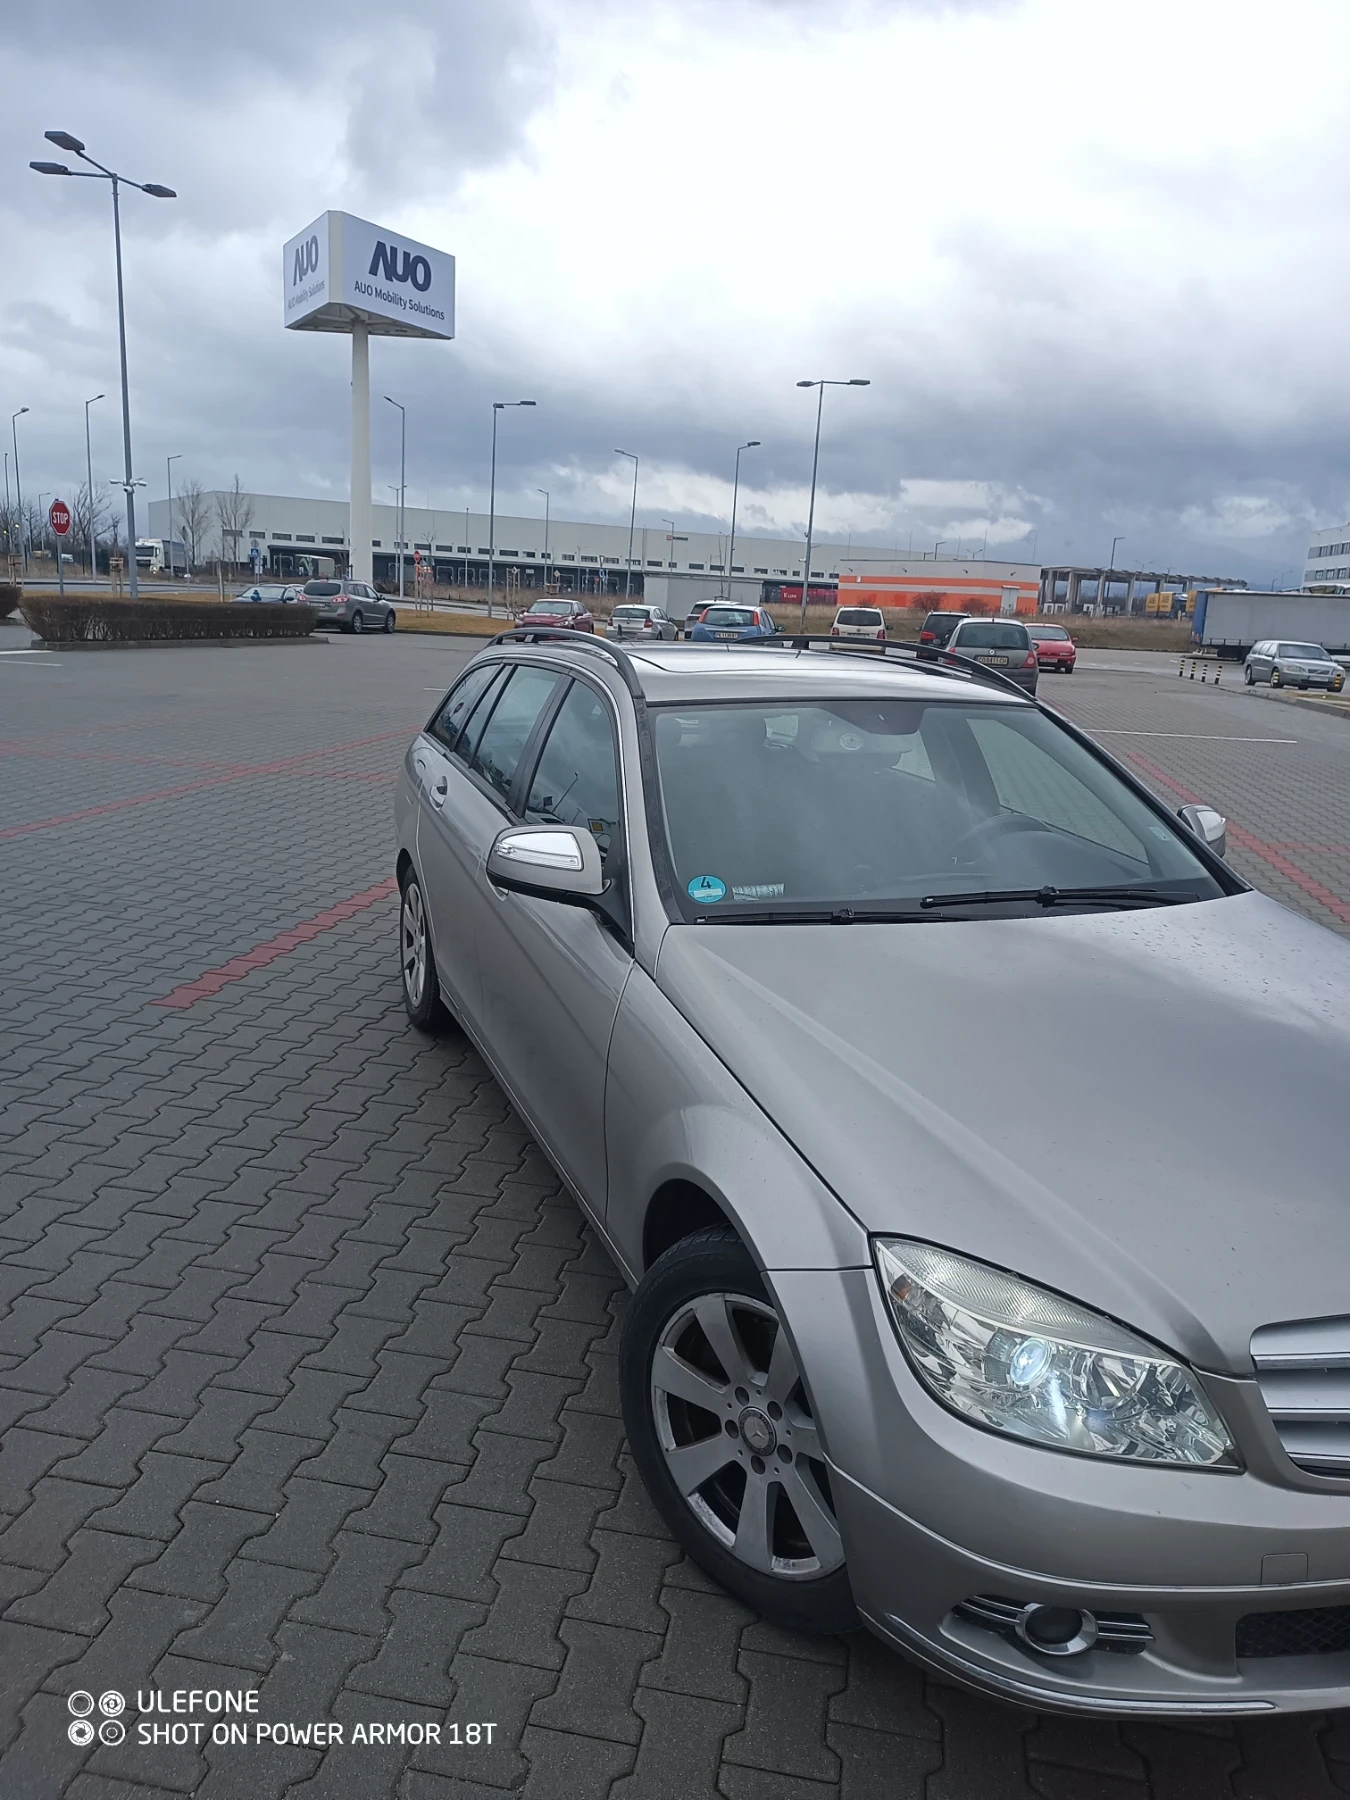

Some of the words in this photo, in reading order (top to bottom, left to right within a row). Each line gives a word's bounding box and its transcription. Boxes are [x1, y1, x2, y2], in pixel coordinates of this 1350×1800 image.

[293, 235, 319, 287] AUO
[368, 240, 432, 292] AUO
[354, 280, 374, 297] AUO
[374, 287, 407, 310] Mobility
[408, 299, 445, 320] Solutions
[52, 511, 69, 525] STOP
[700, 876, 712, 889] 4
